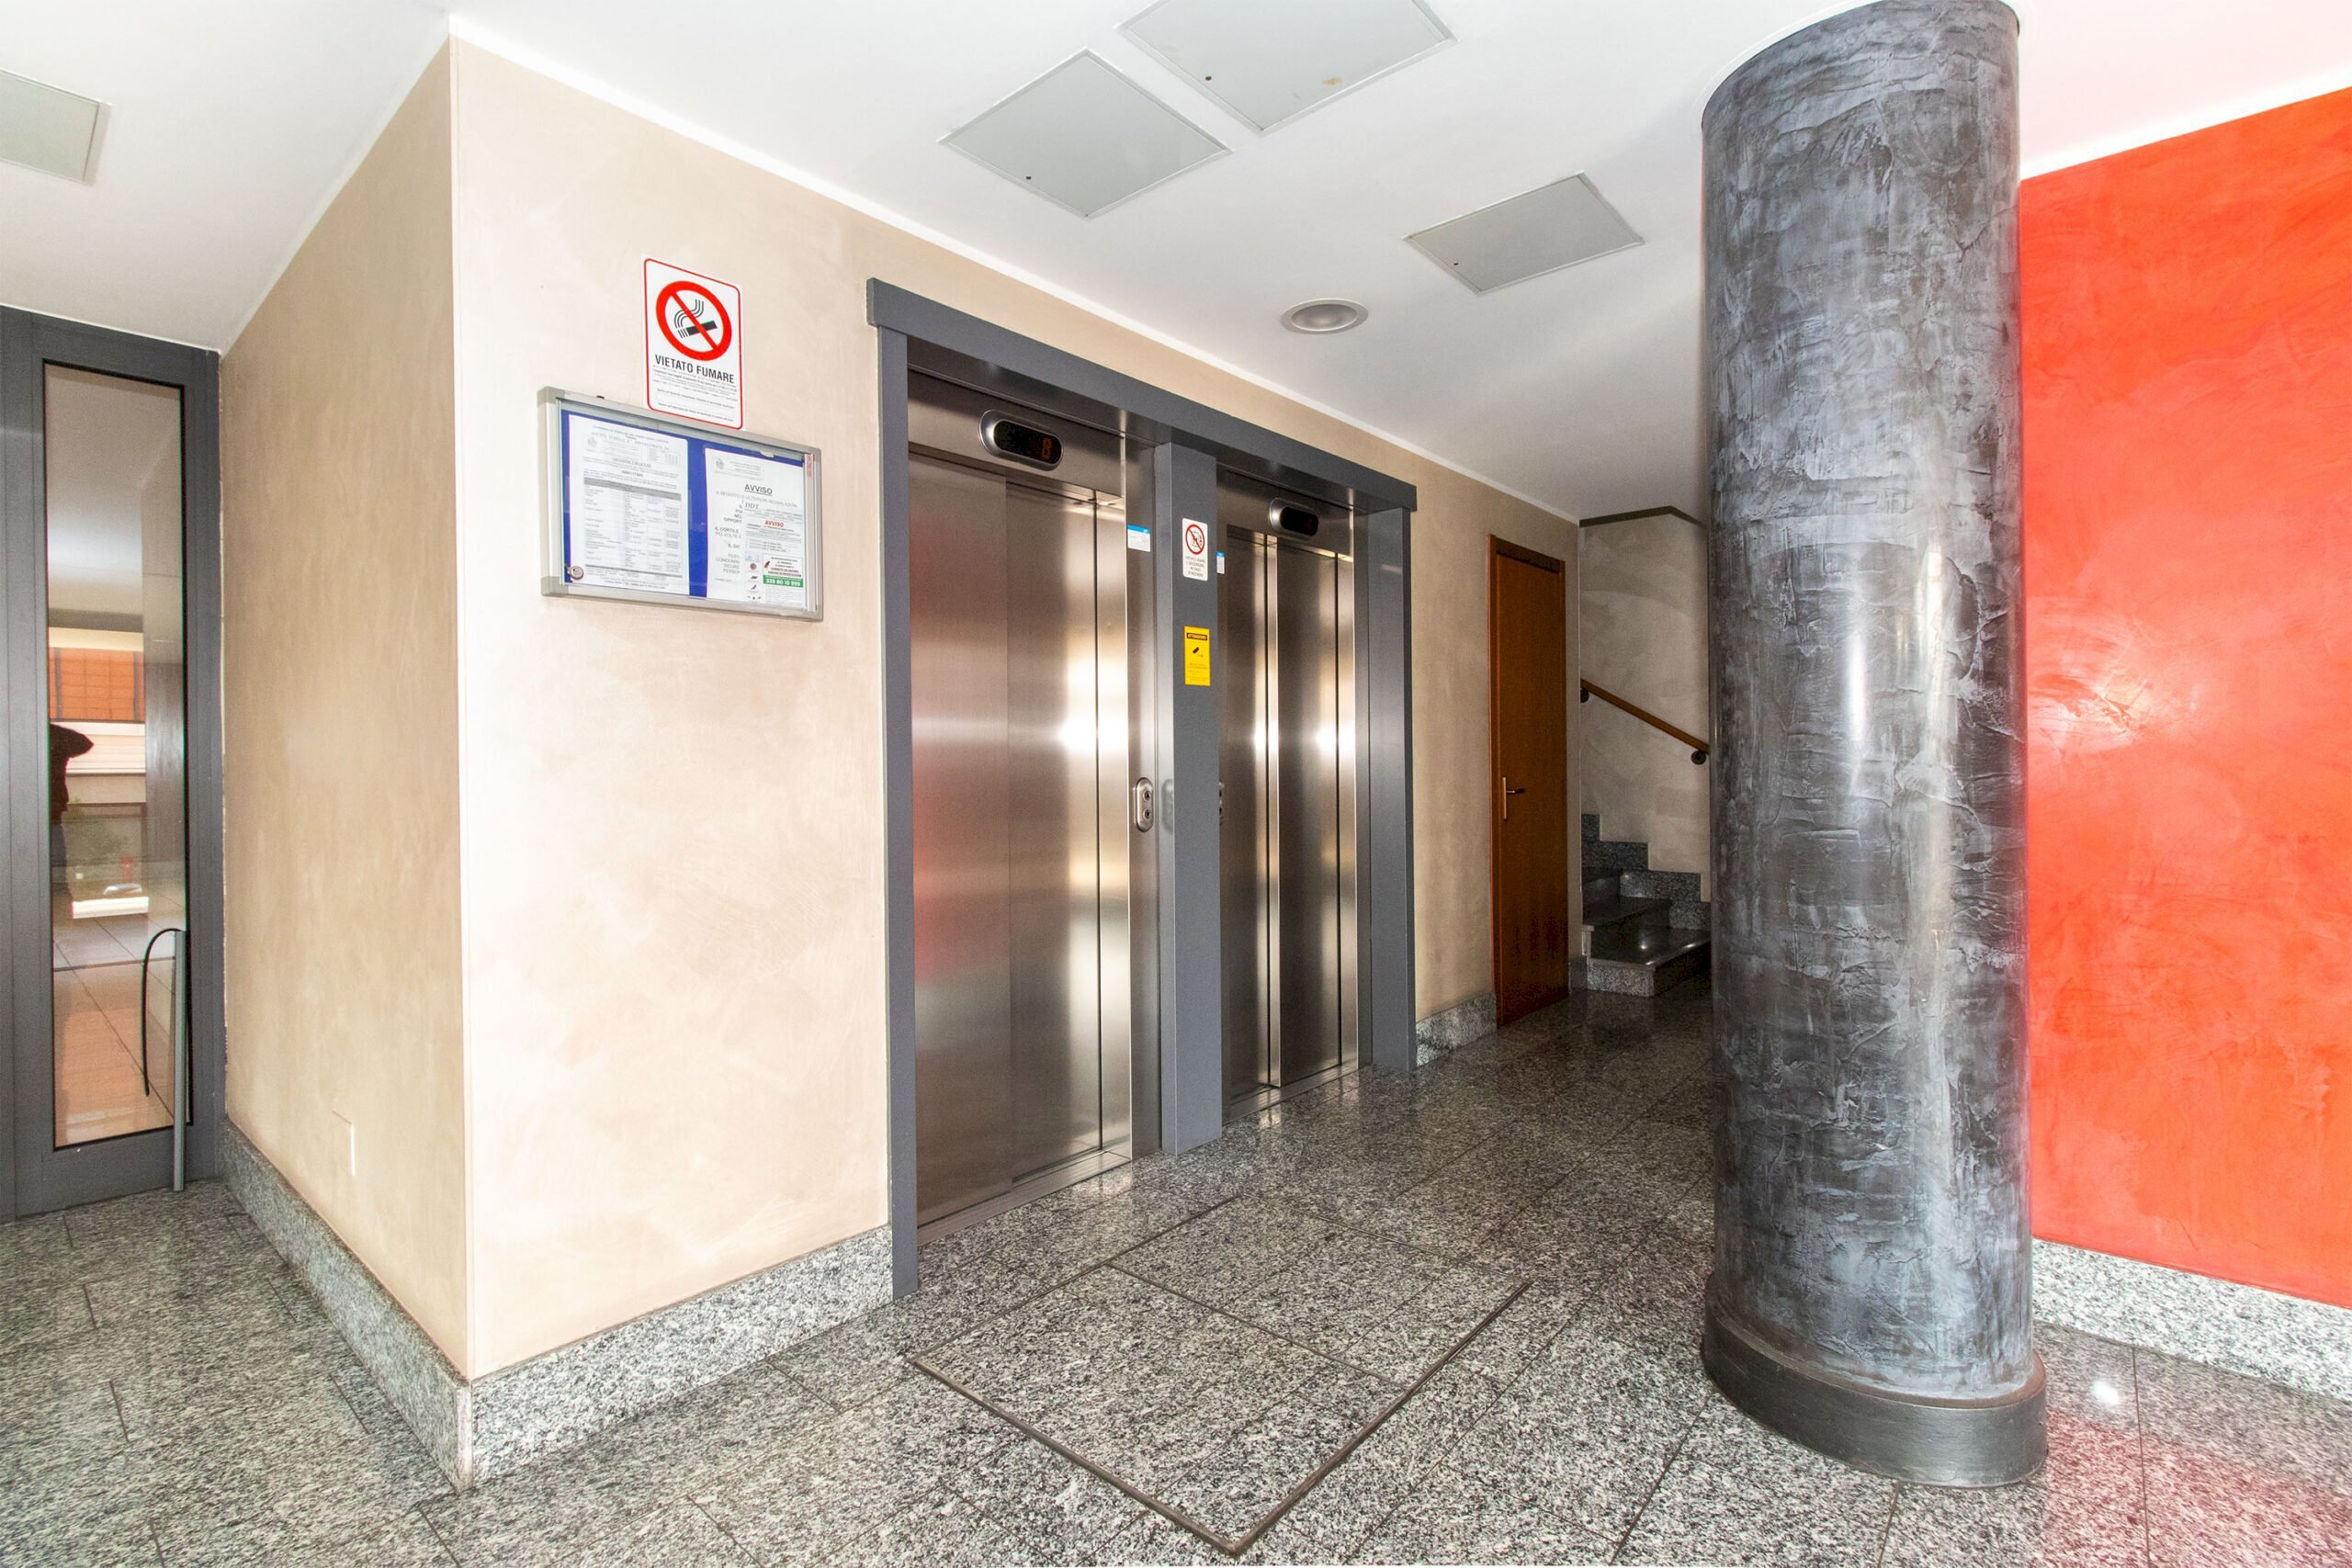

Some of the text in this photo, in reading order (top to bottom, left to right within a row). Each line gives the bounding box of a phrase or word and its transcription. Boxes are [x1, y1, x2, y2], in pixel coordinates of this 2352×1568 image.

[655, 354, 735, 384] VIETATO FUMARE
[744, 484, 773, 496] AVVISO
[764, 520, 785, 528] AVVISO
